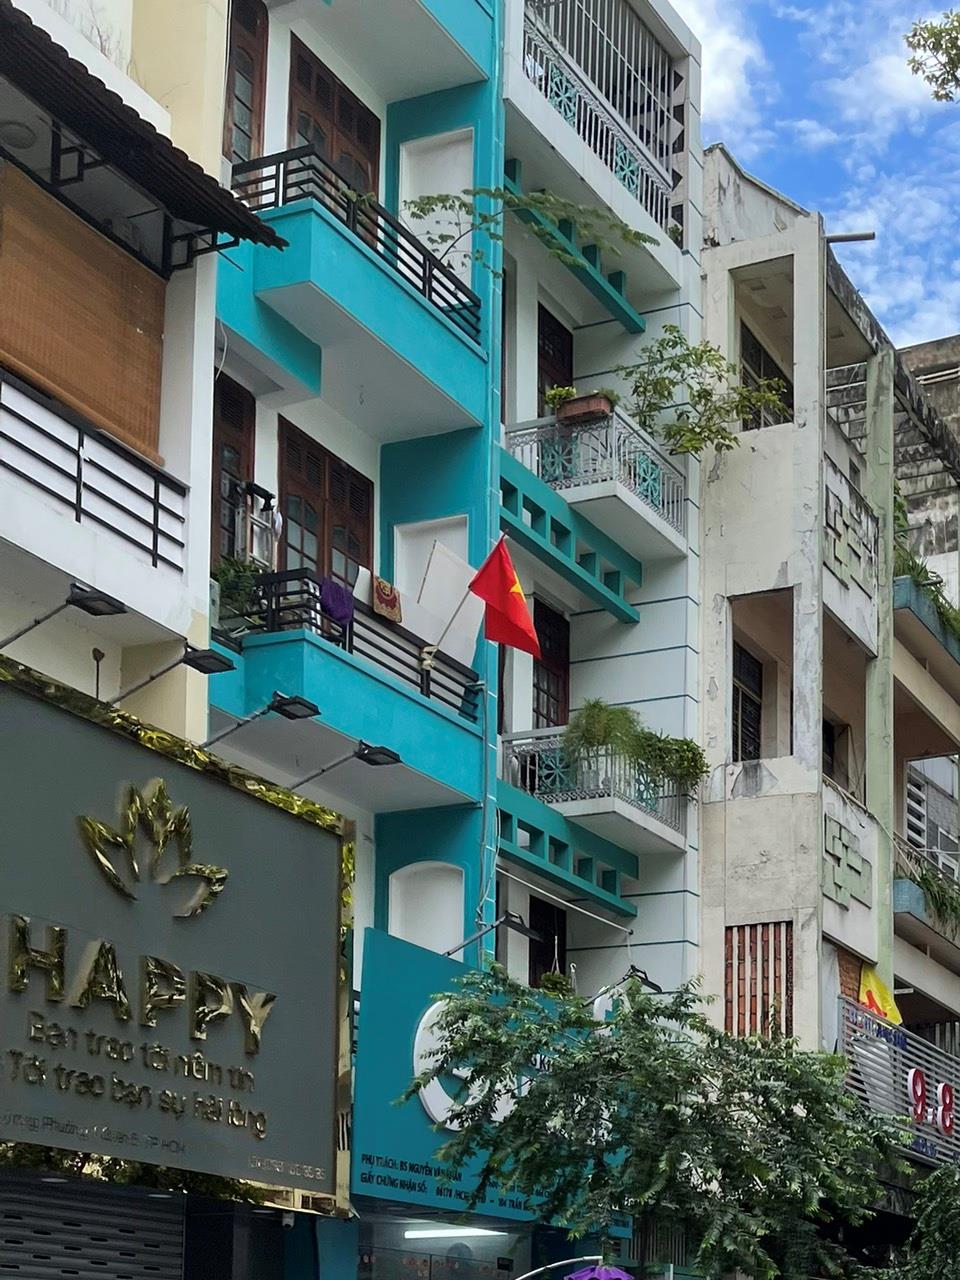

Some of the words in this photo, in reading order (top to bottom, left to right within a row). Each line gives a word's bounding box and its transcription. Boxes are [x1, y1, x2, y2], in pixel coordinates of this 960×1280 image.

[8, 914, 277, 1055] HAPPY
[84, 1029, 135, 1062] trao
[54, 1063, 105, 1096] trao
